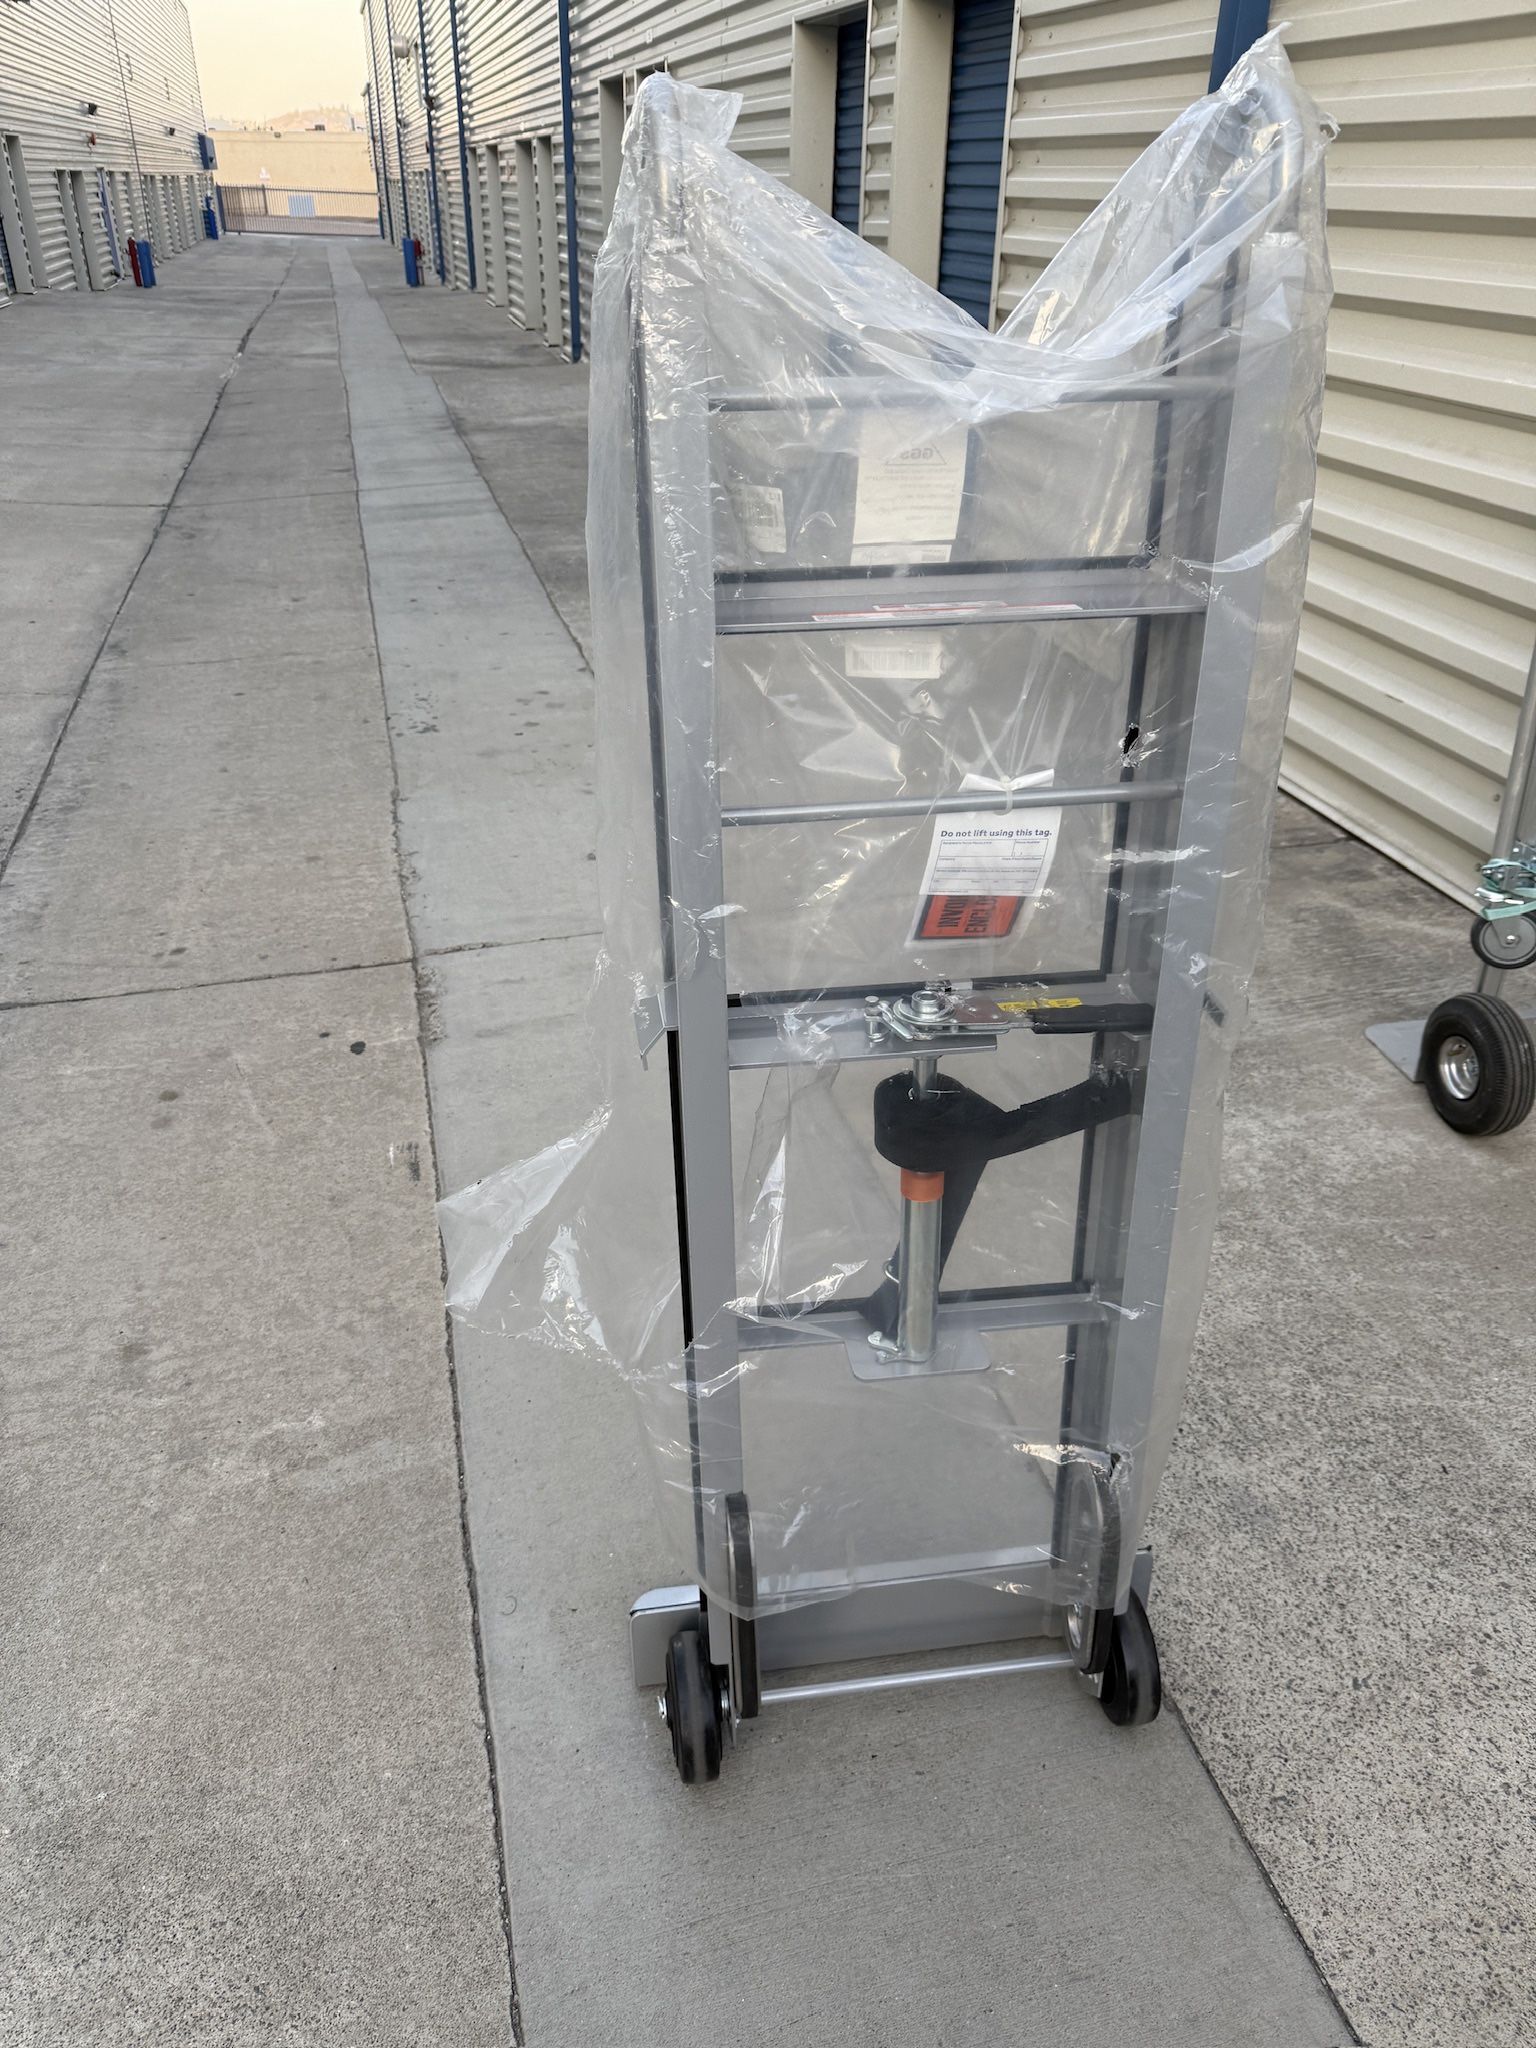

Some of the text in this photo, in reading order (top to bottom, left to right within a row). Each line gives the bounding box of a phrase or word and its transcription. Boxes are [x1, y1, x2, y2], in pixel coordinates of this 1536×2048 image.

[973, 829, 988, 837] lift
[989, 829, 1014, 838] using
[1016, 829, 1033, 837] this
[1035, 829, 1052, 838] tag.
